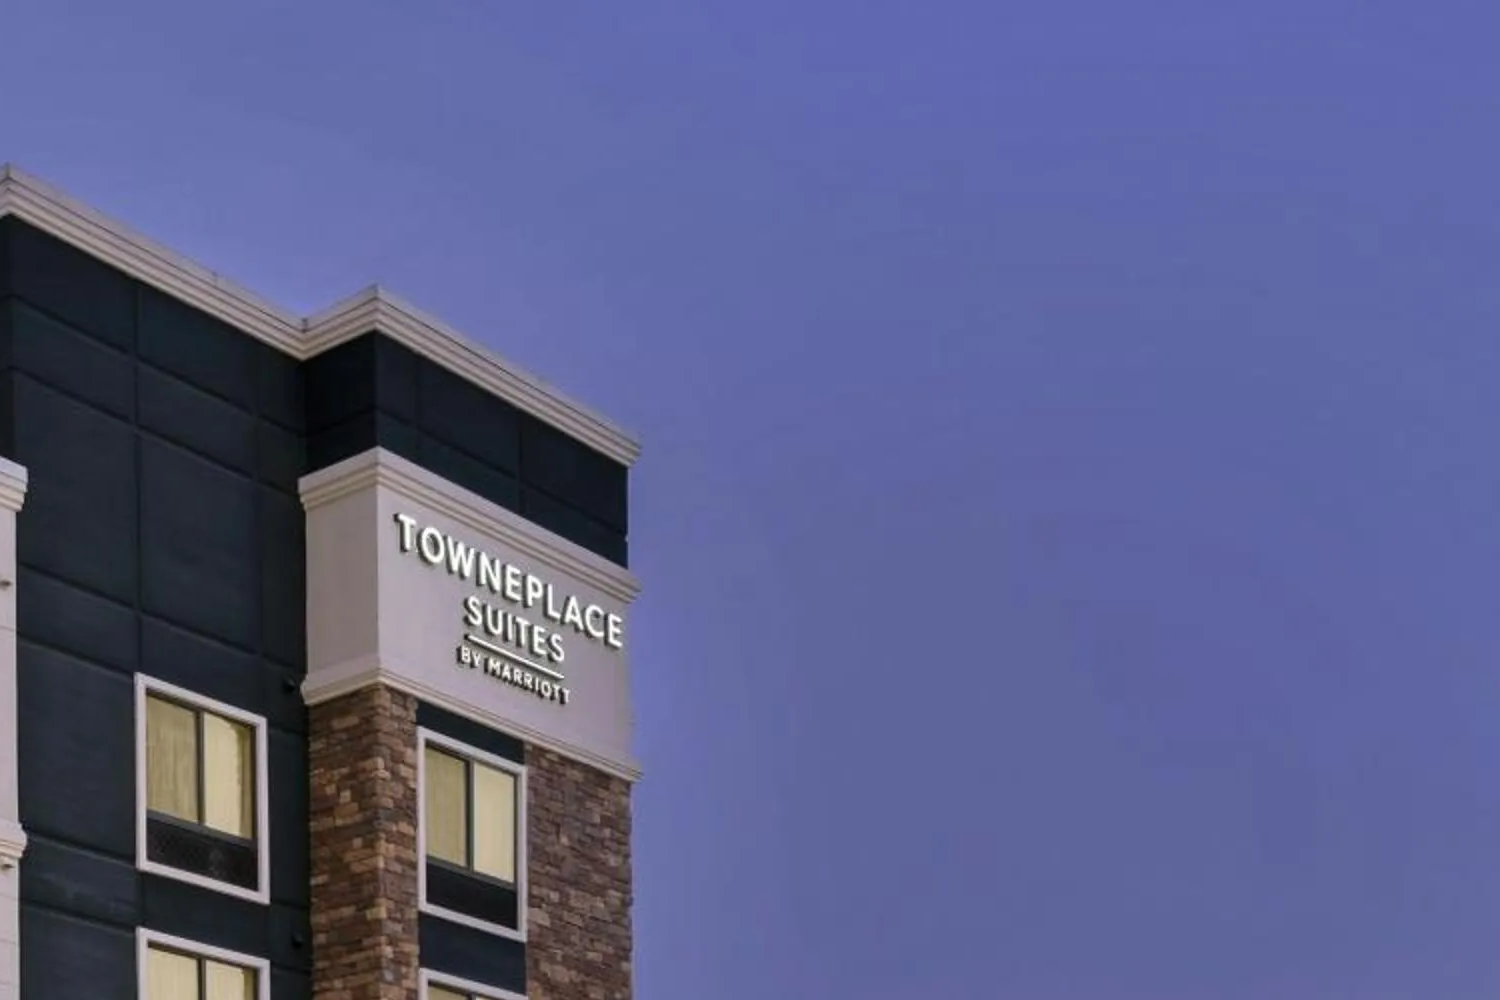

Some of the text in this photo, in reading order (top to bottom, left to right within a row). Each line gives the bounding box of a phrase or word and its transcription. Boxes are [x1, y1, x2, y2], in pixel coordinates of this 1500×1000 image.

[396, 513, 623, 649] TOWNEPLACE
[465, 596, 565, 663] SUITES
[459, 646, 571, 704] BY MARRIOTT
